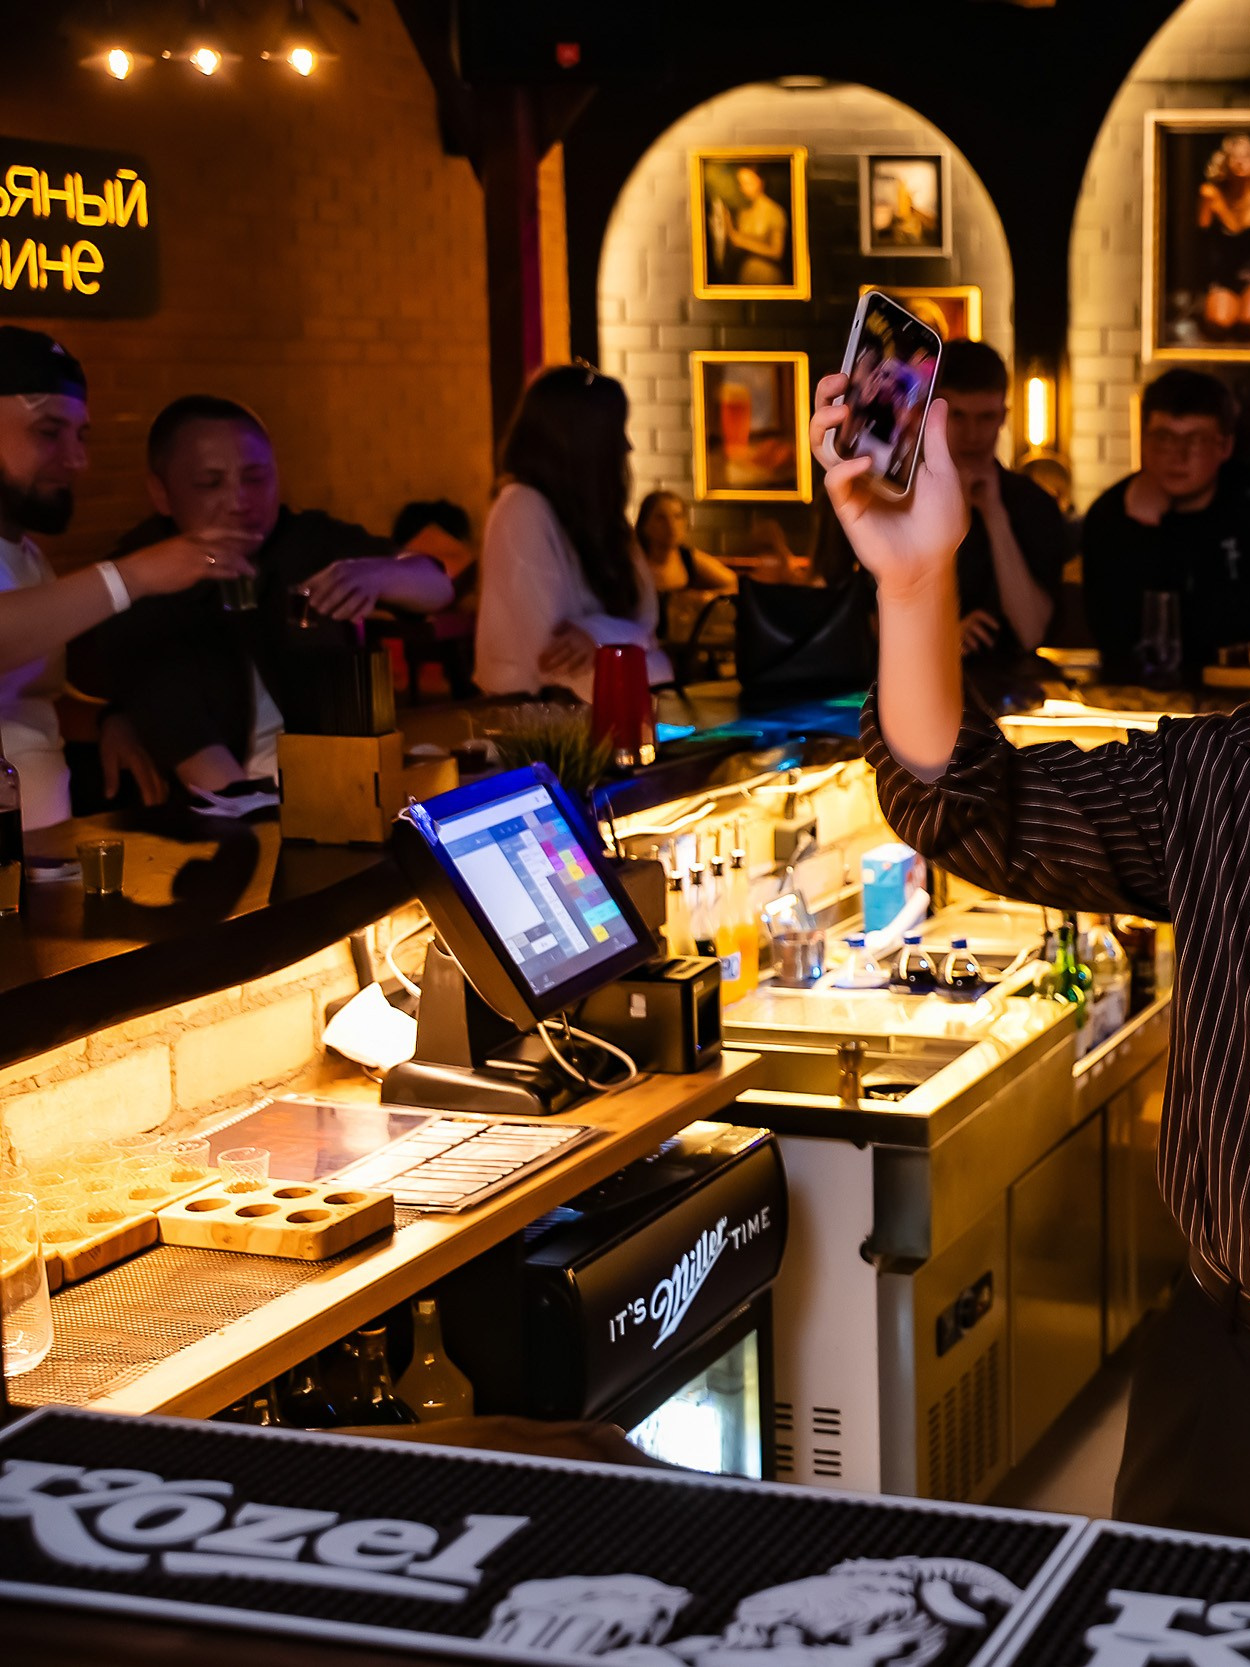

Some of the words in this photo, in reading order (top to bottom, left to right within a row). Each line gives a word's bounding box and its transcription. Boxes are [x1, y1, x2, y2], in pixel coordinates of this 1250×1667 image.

[0, 238, 104, 295] ине
[609, 1297, 647, 1343] IT'S
[650, 1216, 729, 1350] Miller
[729, 1206, 771, 1250] TIME
[0, 1459, 530, 1599] Kozel
